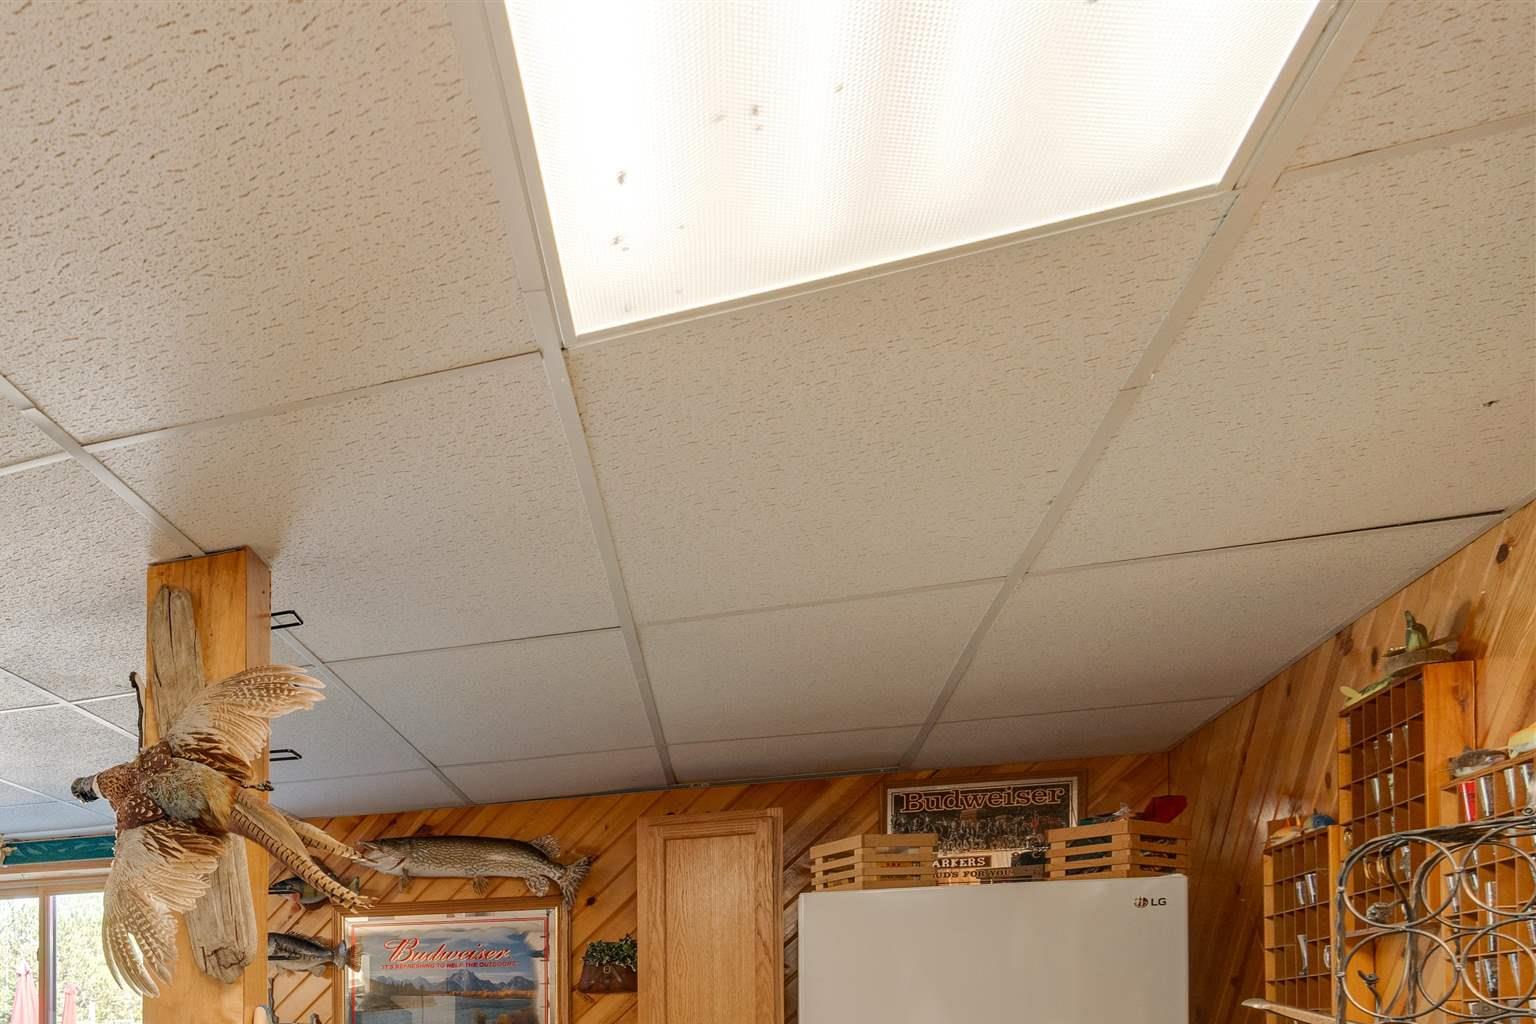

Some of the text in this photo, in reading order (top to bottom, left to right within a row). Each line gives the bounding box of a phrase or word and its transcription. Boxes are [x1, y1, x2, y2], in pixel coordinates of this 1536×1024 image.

[900, 786, 1065, 814] Budweiser
[932, 857, 985, 868] ARKERS
[934, 870, 959, 879] UD'S
[964, 870, 984, 878] FOR
[1150, 897, 1167, 907] LG
[384, 937, 512, 962] Budweiser
